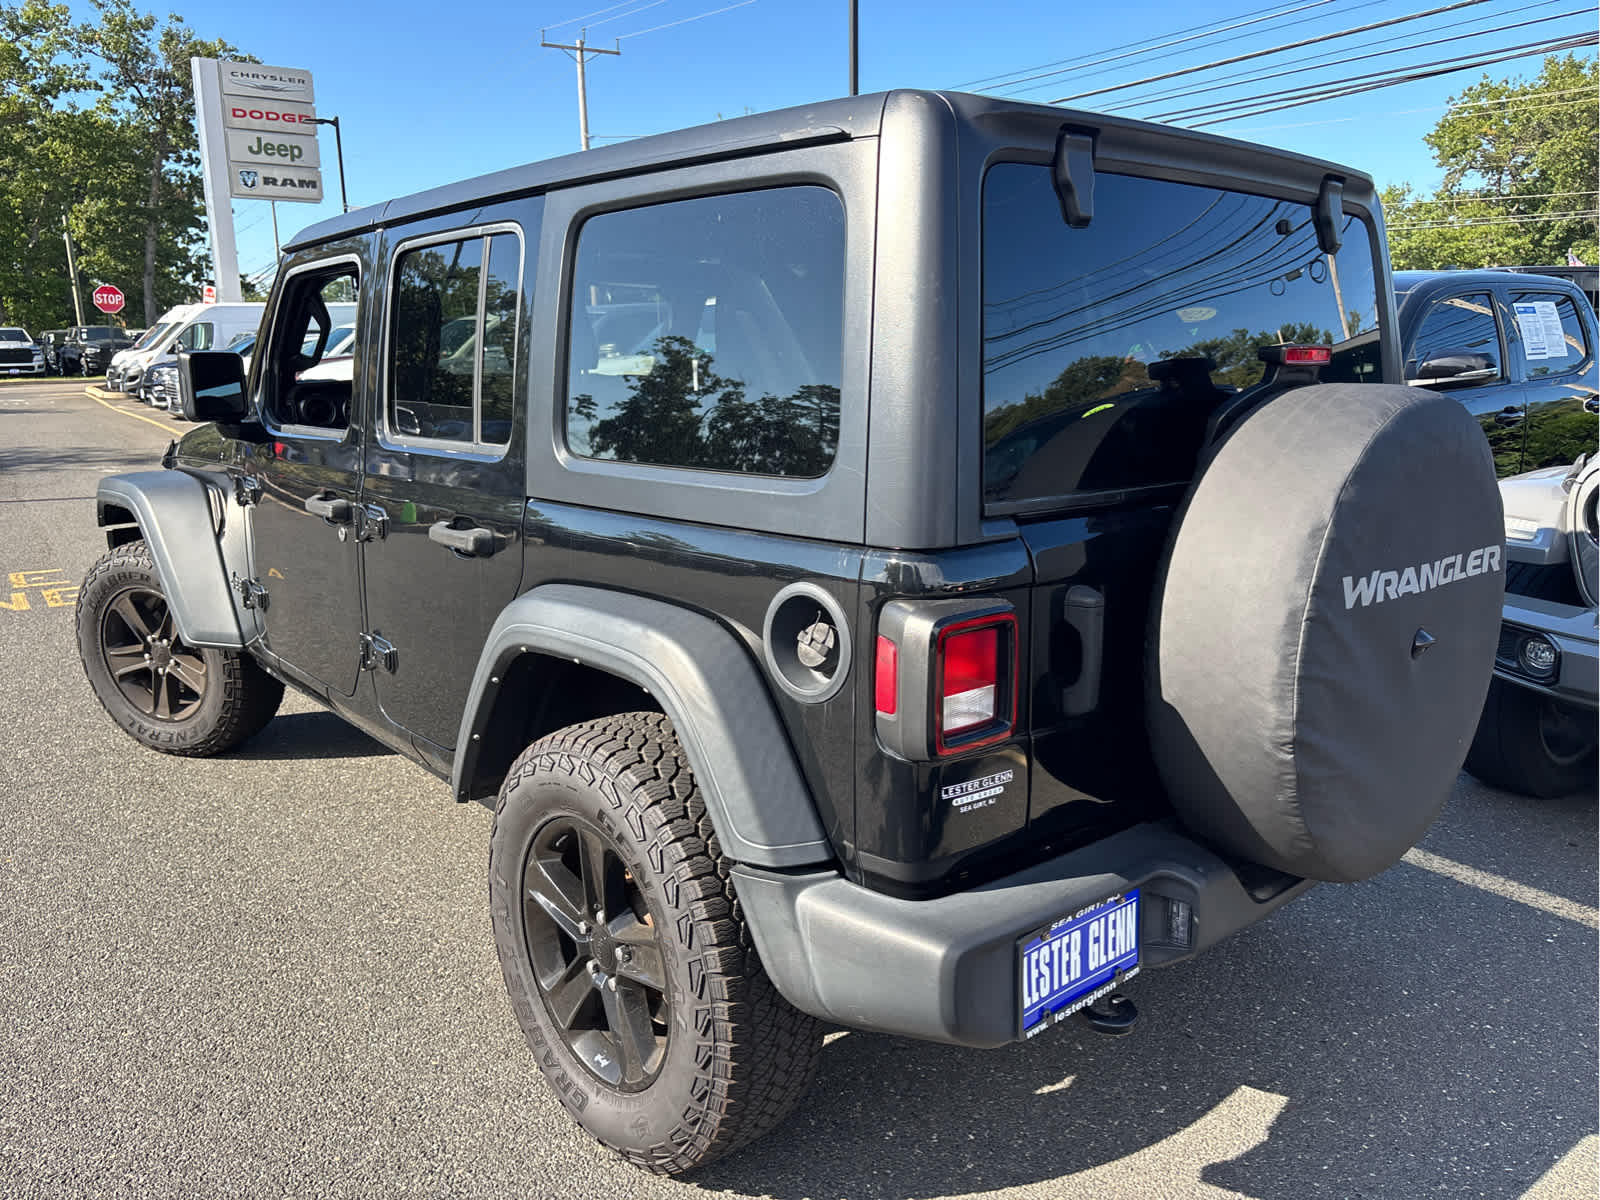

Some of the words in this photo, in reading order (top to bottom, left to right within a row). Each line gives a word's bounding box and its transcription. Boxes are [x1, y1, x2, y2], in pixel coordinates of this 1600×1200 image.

[230, 71, 306, 85] CHRYSLER
[231, 108, 314, 125] DODGE
[248, 136, 303, 162] Jeep
[262, 176, 318, 190] RAM
[95, 292, 124, 306] STOP
[1342, 545, 1502, 610] WRANGLER
[941, 781, 980, 797] LESTER
[982, 771, 1013, 787] GLENN
[959, 805, 973, 814] SEA
[1051, 915, 1073, 930] SEA
[1023, 929, 1081, 1010] LESTER
[1088, 901, 1137, 972] GLENN
